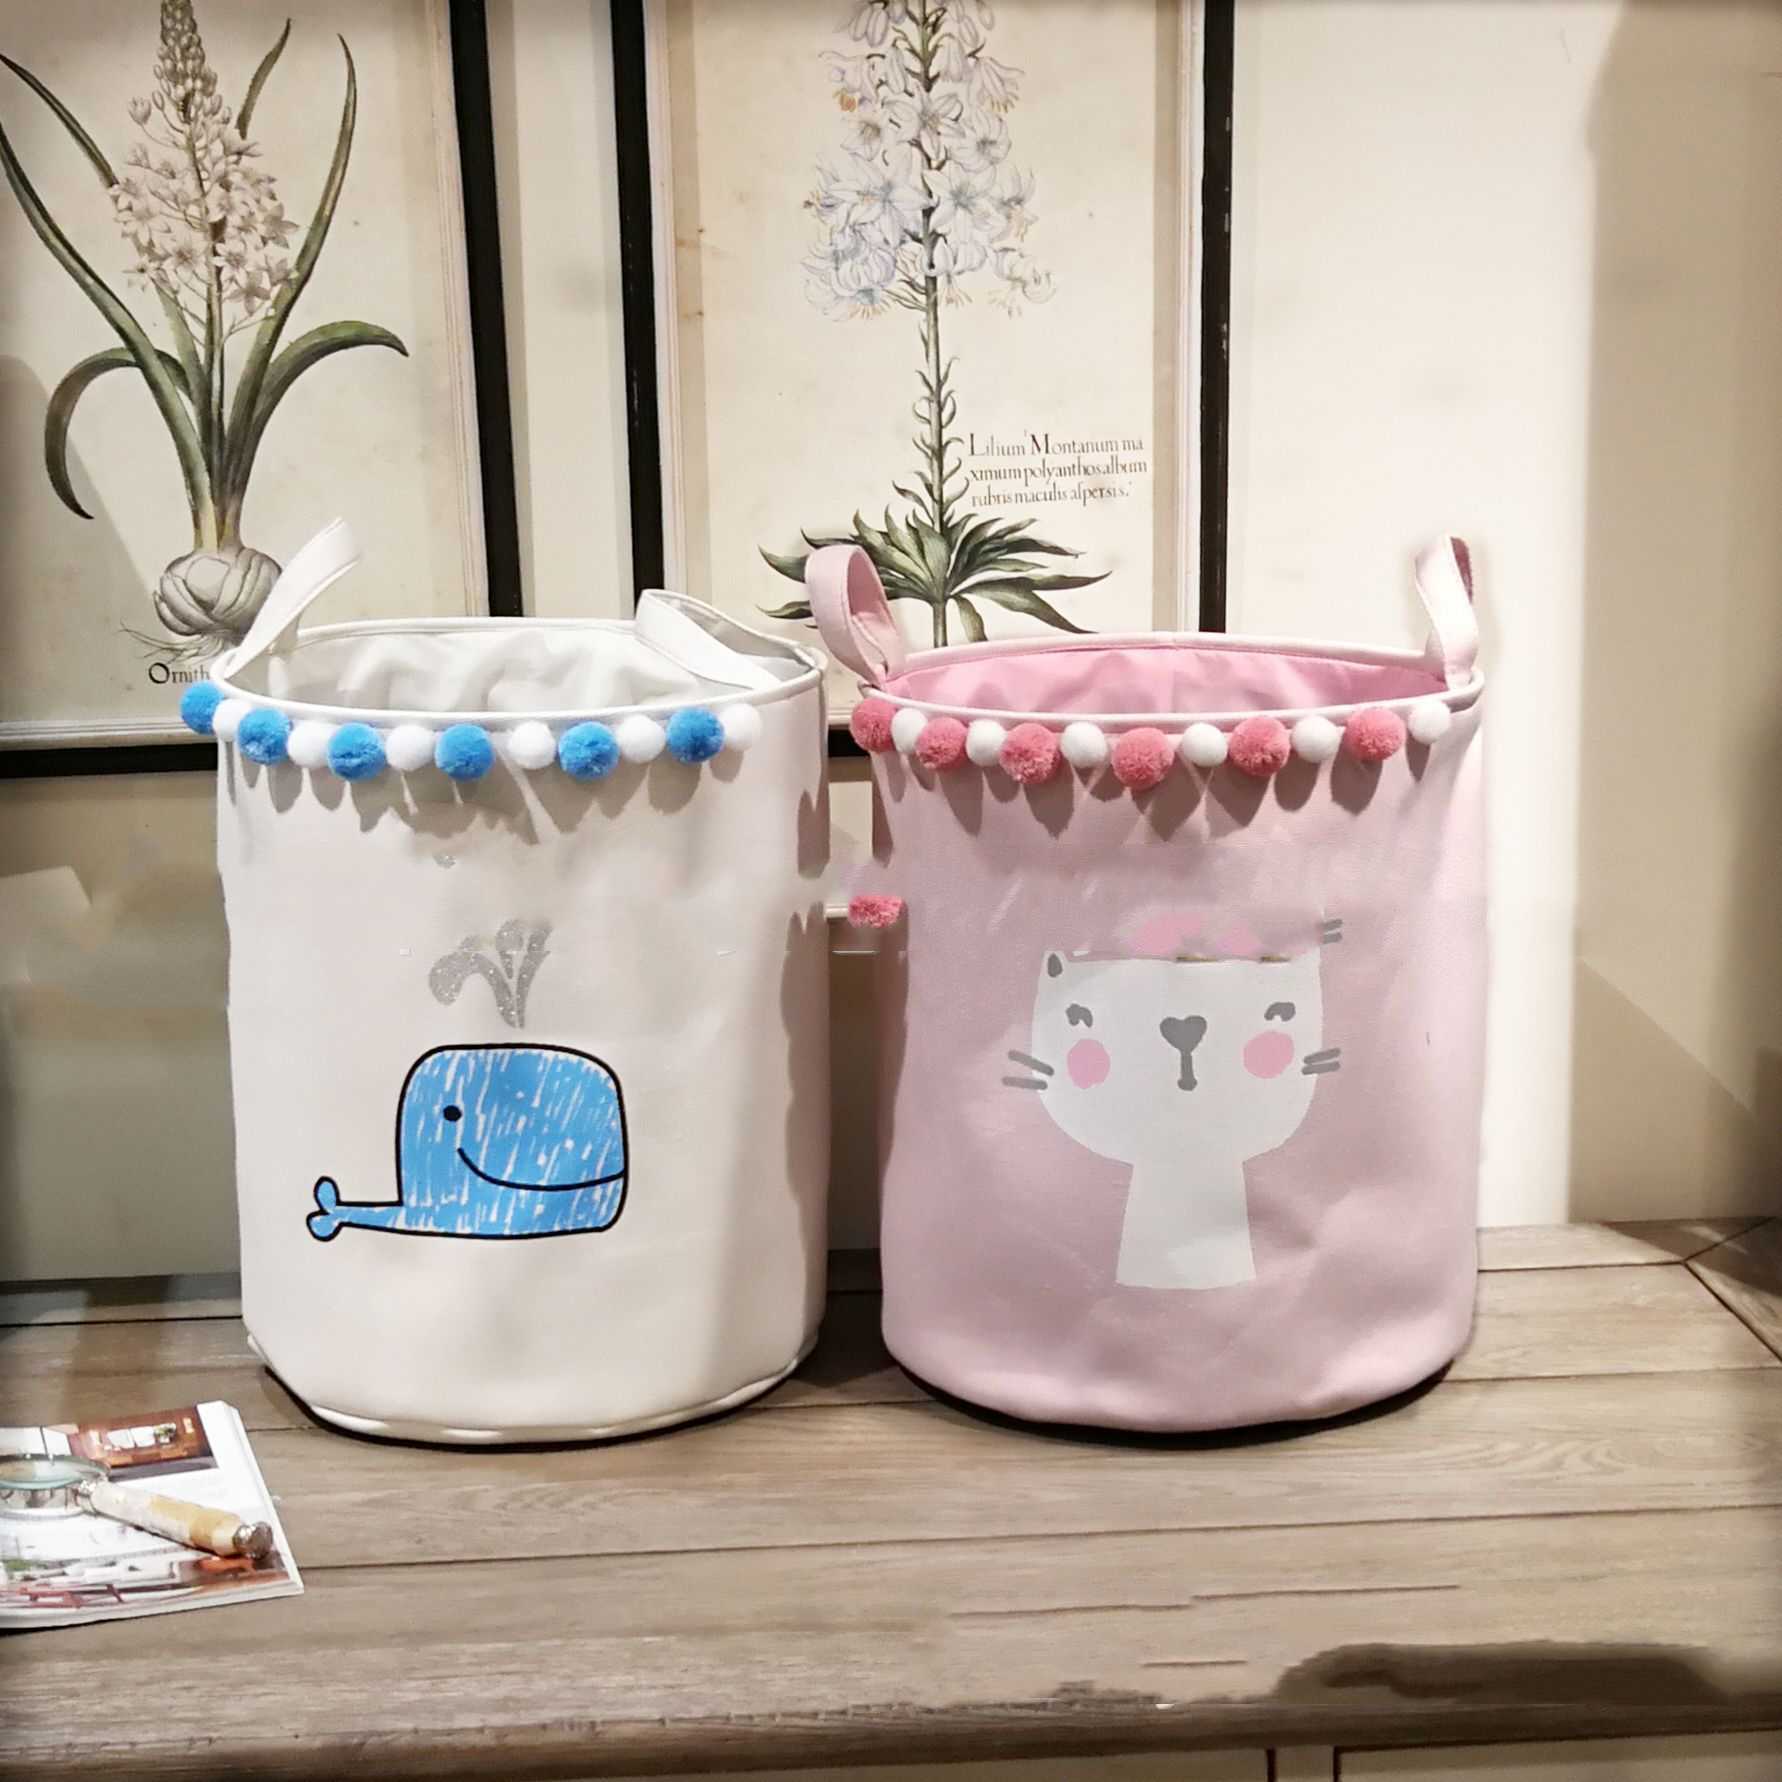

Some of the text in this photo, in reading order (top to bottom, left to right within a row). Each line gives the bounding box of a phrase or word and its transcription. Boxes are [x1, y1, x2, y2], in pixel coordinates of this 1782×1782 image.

[969, 433, 1144, 457] Lilium Montanum ma
